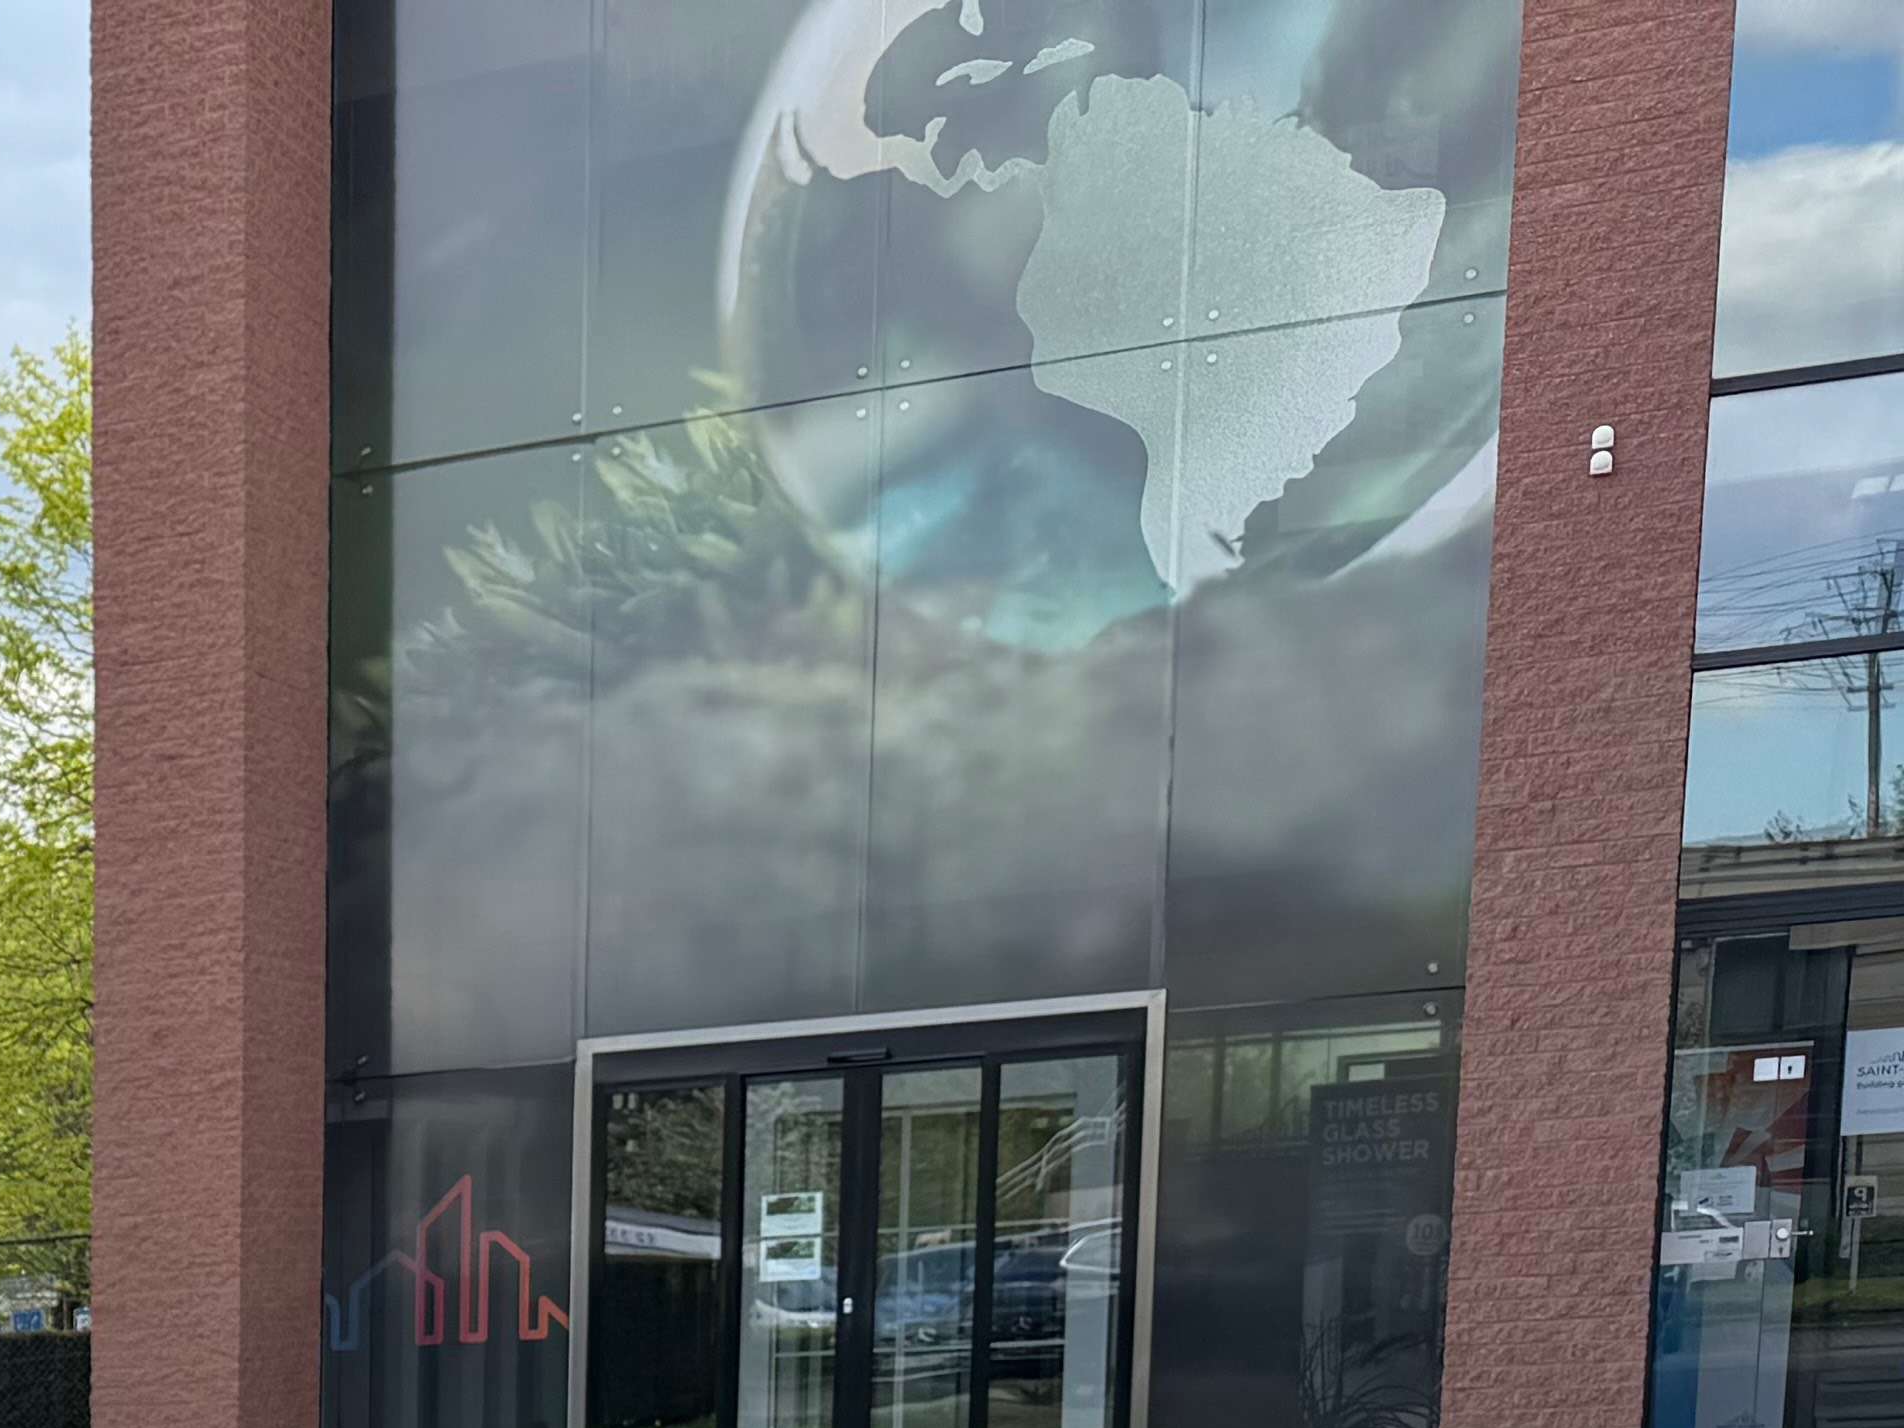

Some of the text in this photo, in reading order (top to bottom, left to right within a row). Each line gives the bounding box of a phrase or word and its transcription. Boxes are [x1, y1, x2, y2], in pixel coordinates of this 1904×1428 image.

[1326, 1093, 1439, 1119] TIMELESS
[1325, 1120, 1400, 1142] GLASS
[1323, 1140, 1430, 1165] SHOWER
